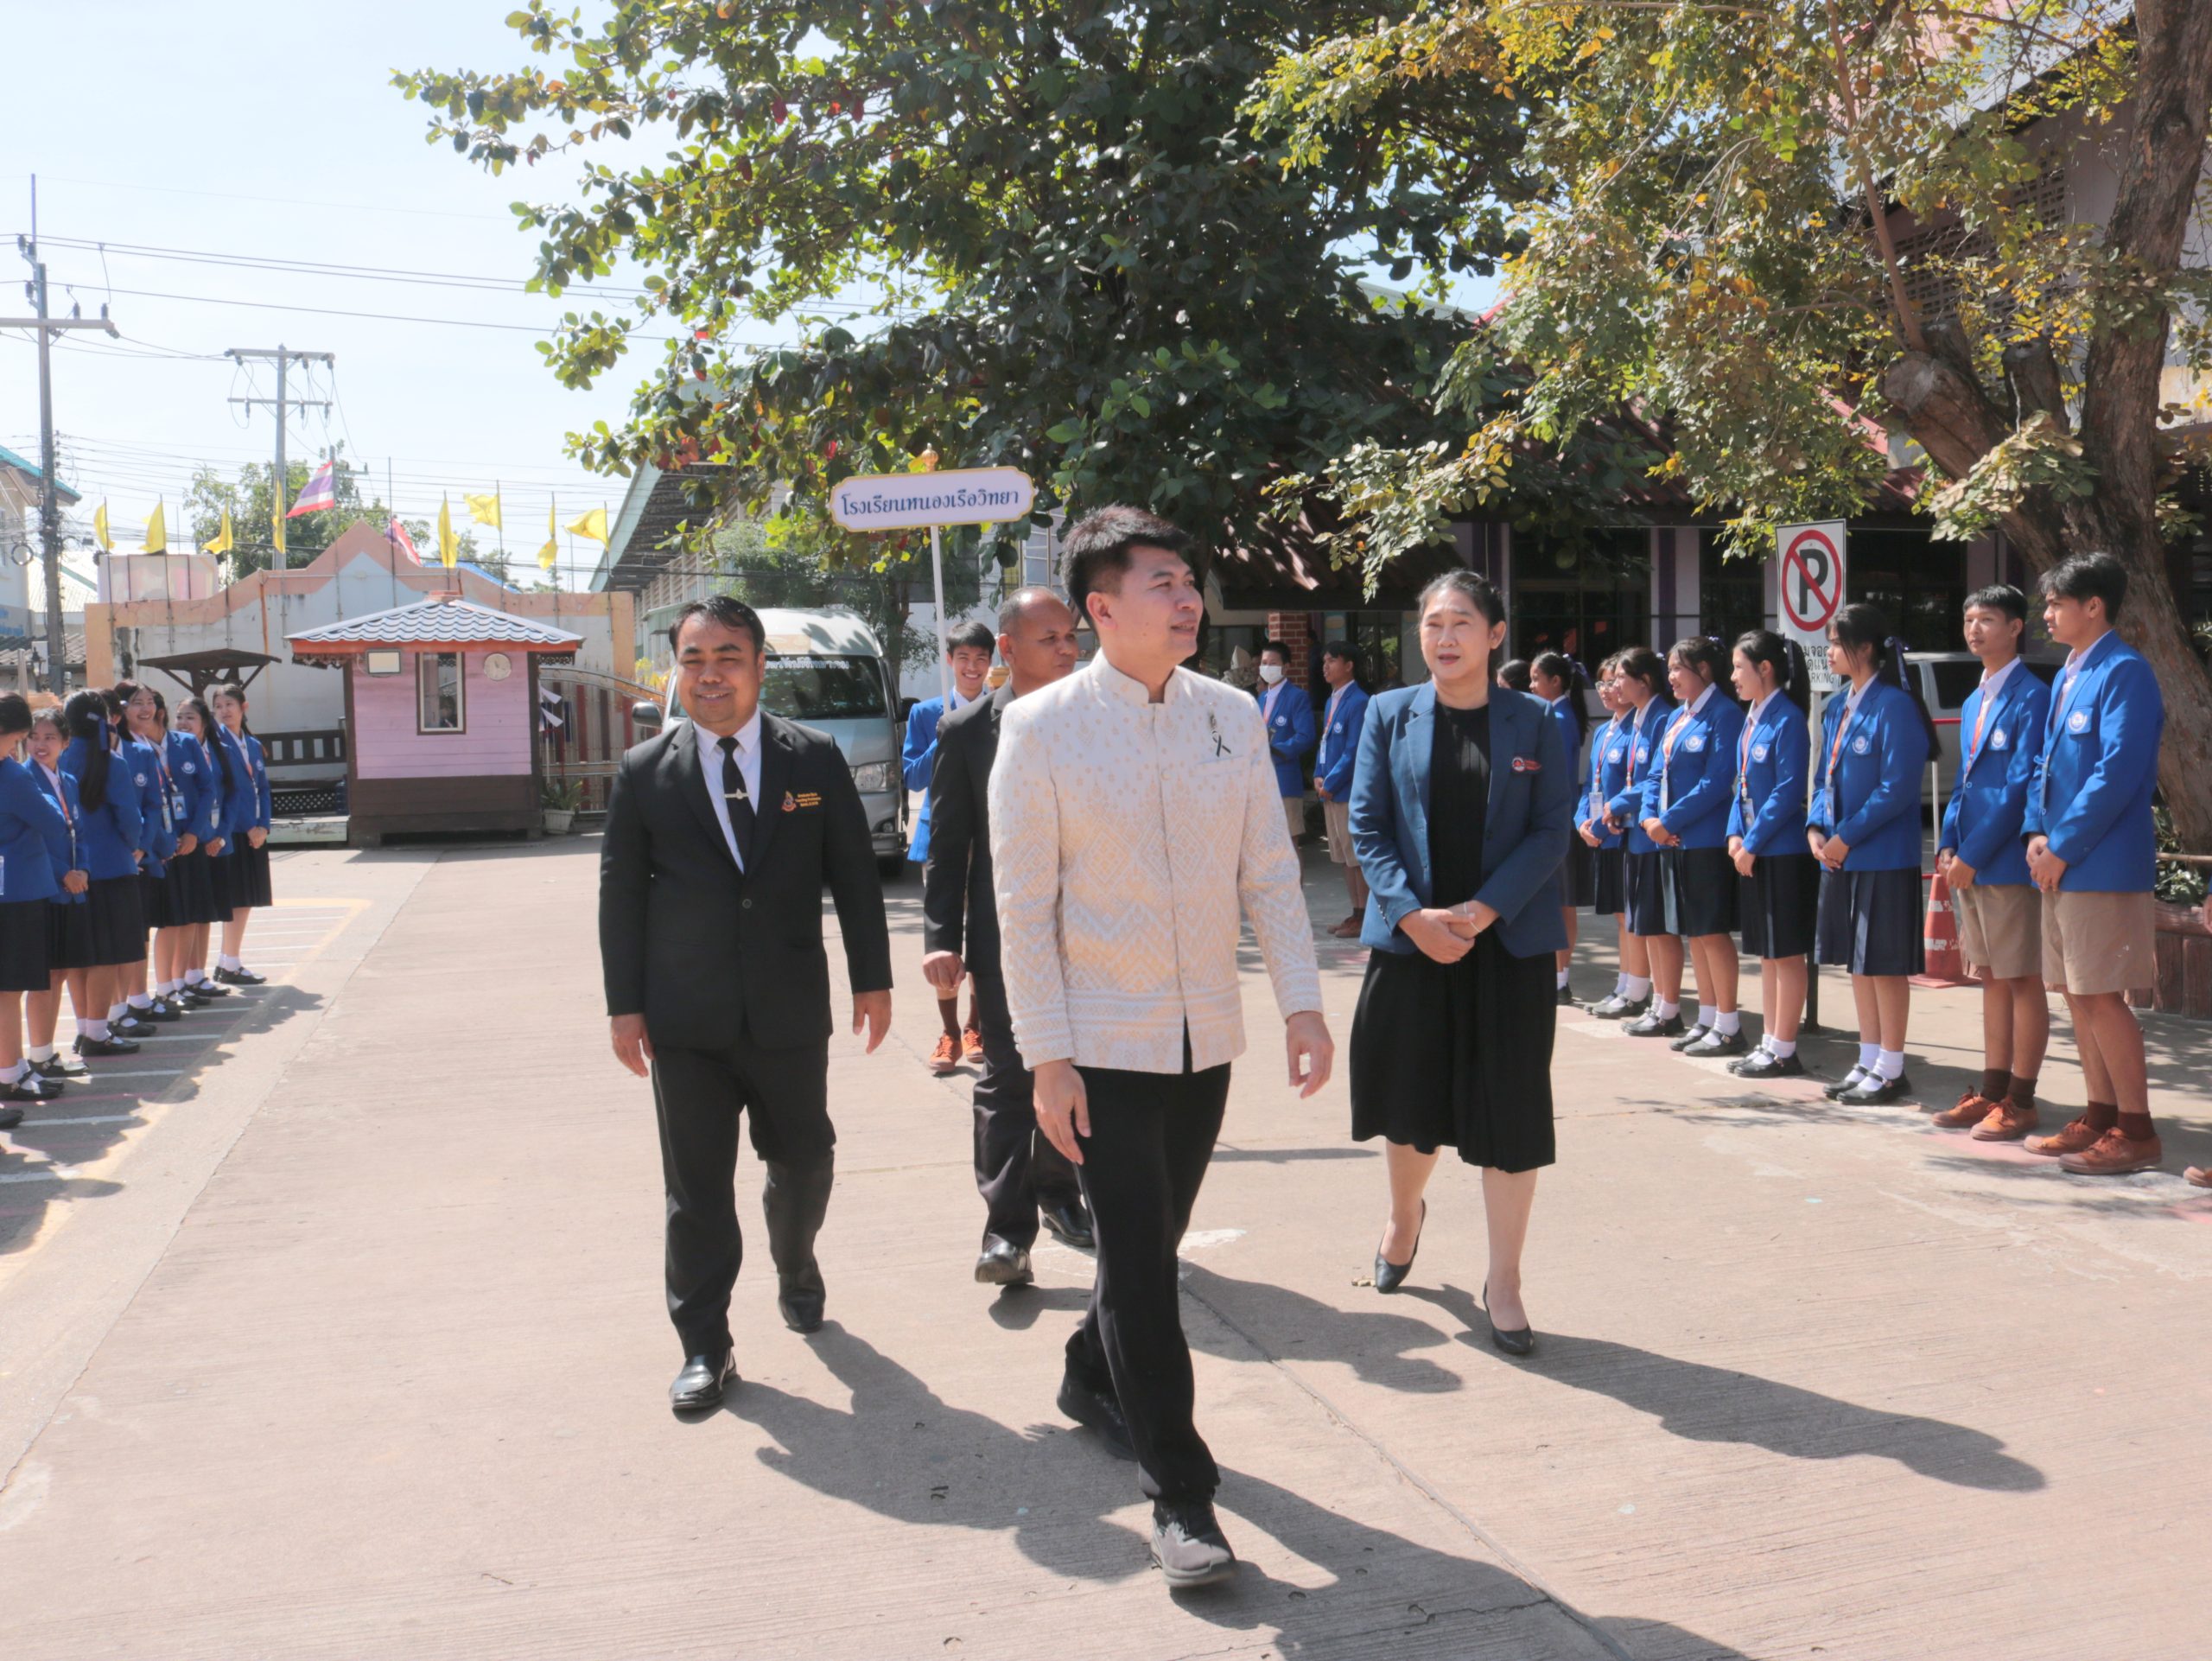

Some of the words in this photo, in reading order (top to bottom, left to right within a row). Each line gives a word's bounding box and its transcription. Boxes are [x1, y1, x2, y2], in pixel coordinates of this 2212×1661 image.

[841, 488, 1019, 516] โรงเรียนหนองเรือวิทยา
[1799, 549, 1828, 614] P
[1810, 672, 1834, 684] RKING
